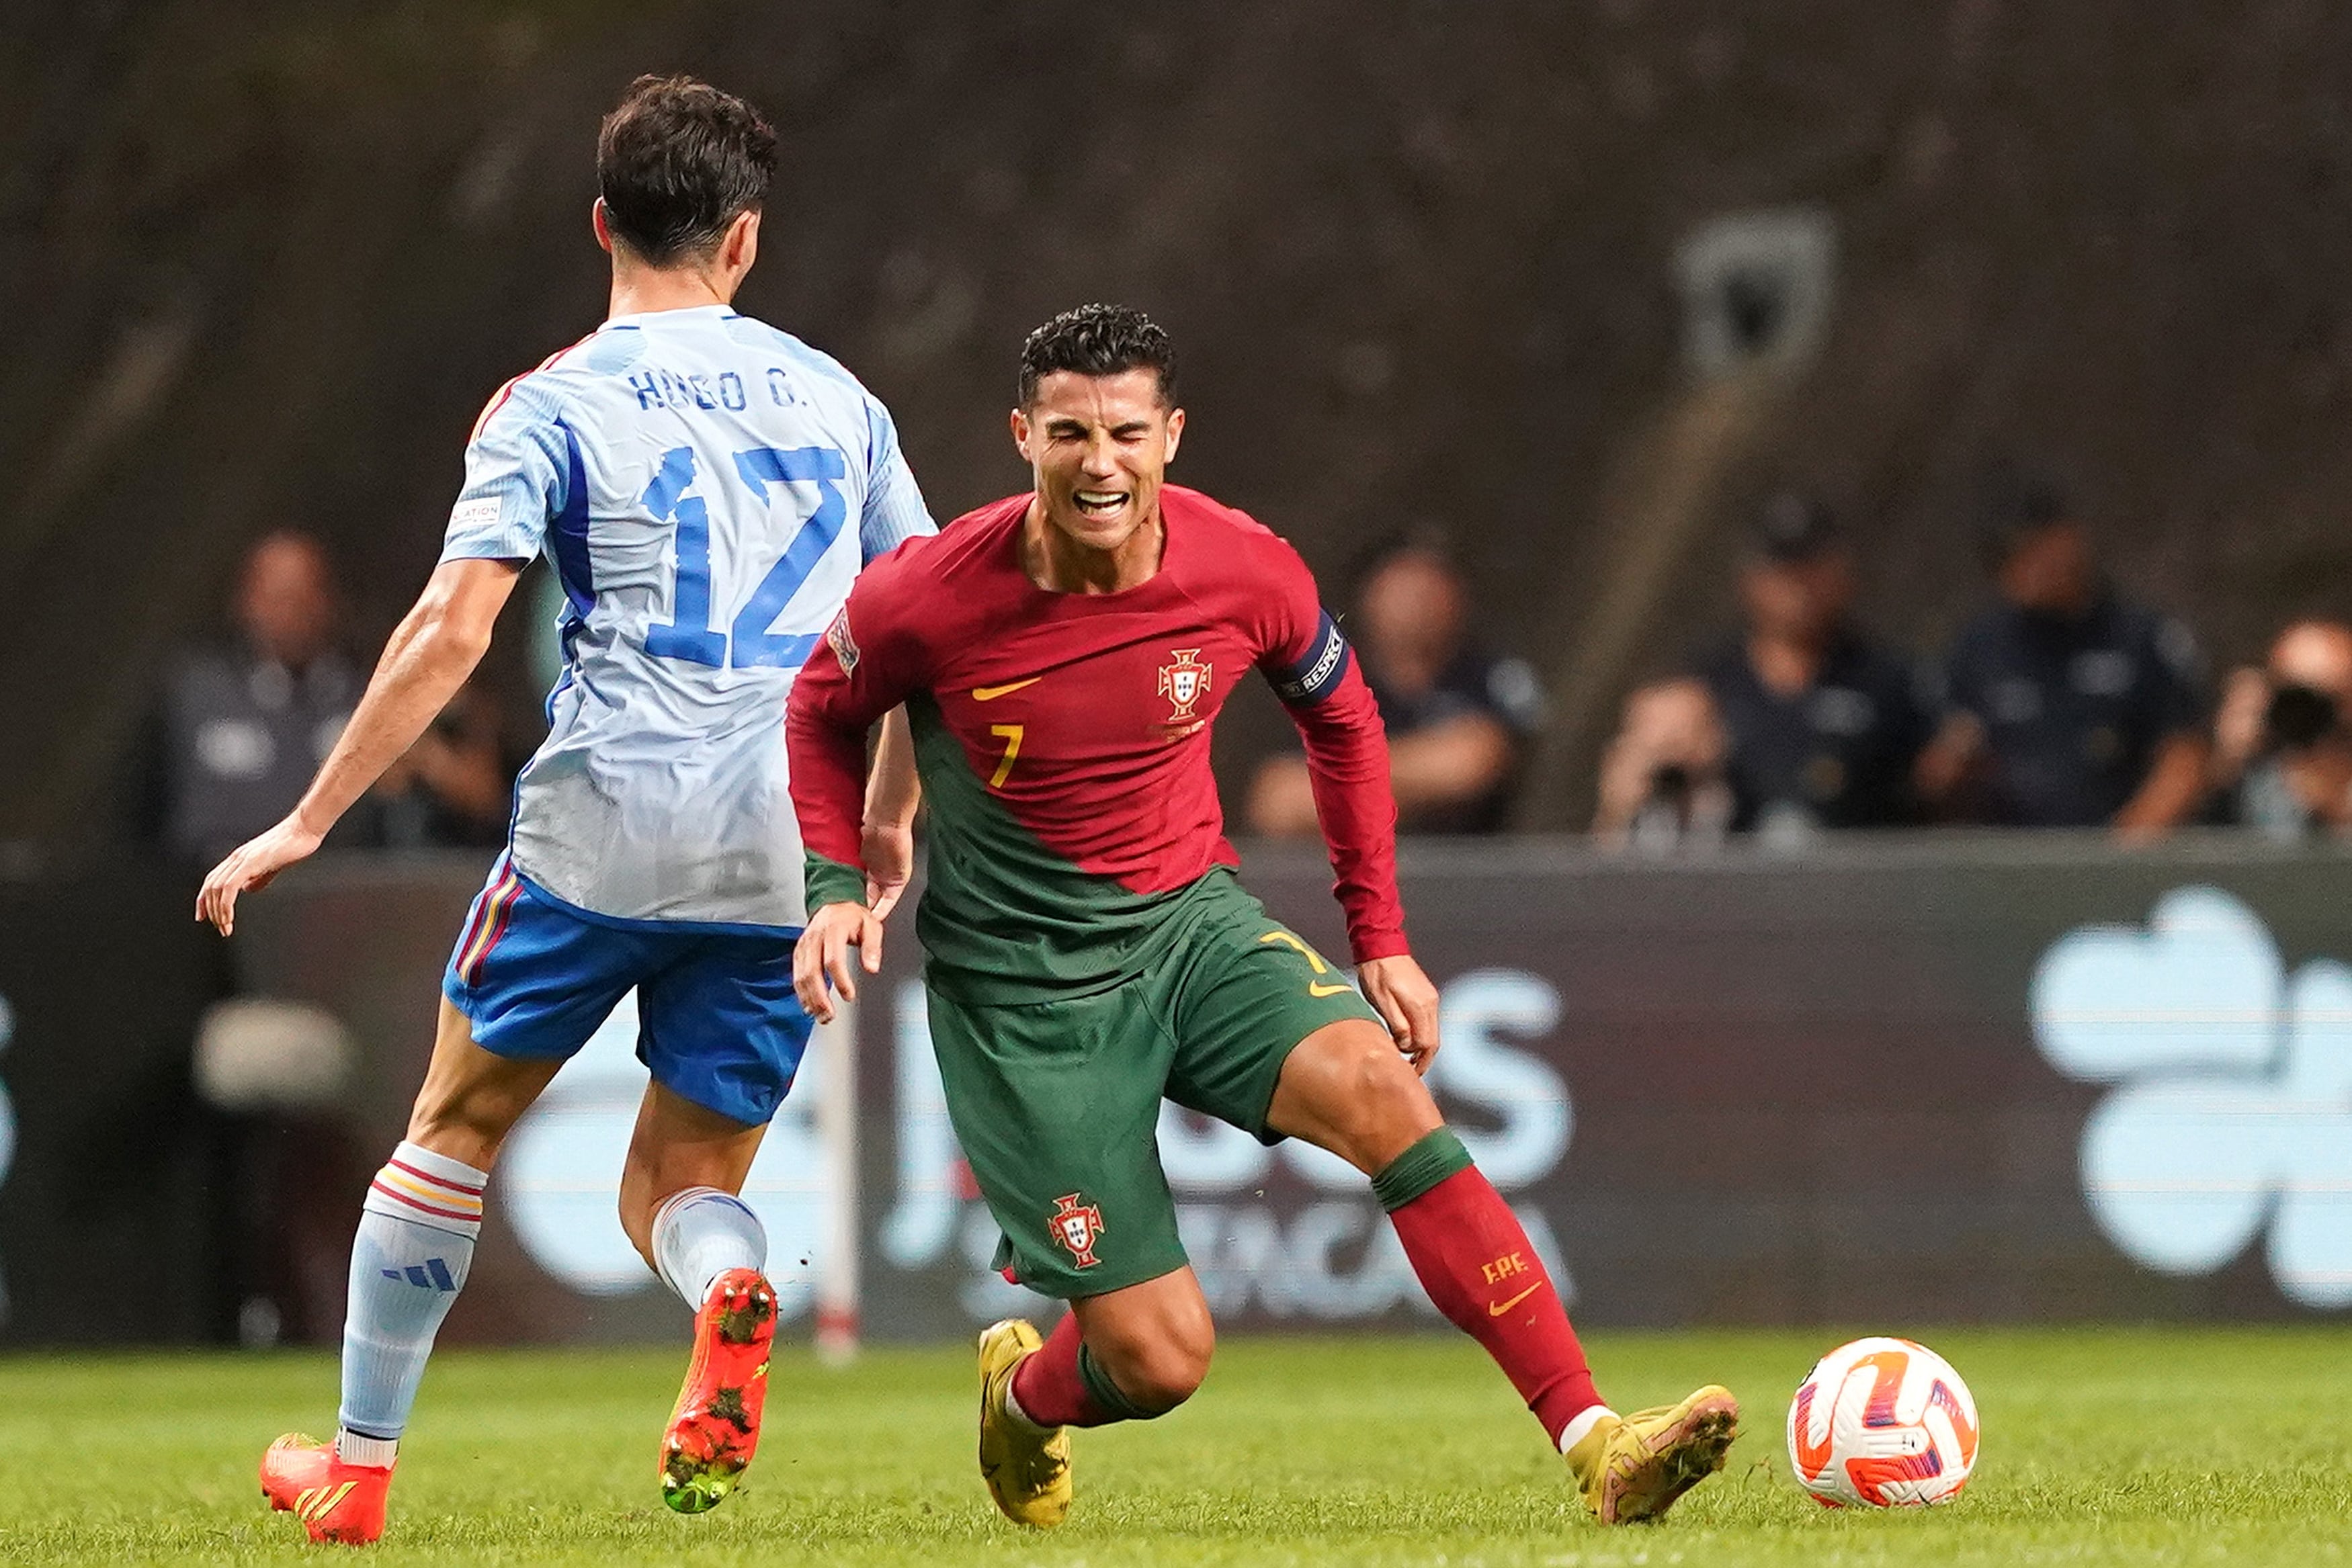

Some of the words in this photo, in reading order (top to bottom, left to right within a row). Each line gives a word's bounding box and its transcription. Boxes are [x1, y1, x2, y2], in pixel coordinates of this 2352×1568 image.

[640, 446, 847, 668] 12
[1302, 628, 1341, 690] RESPECT
[989, 725, 1024, 789] 7
[1259, 931, 1327, 974] 7
